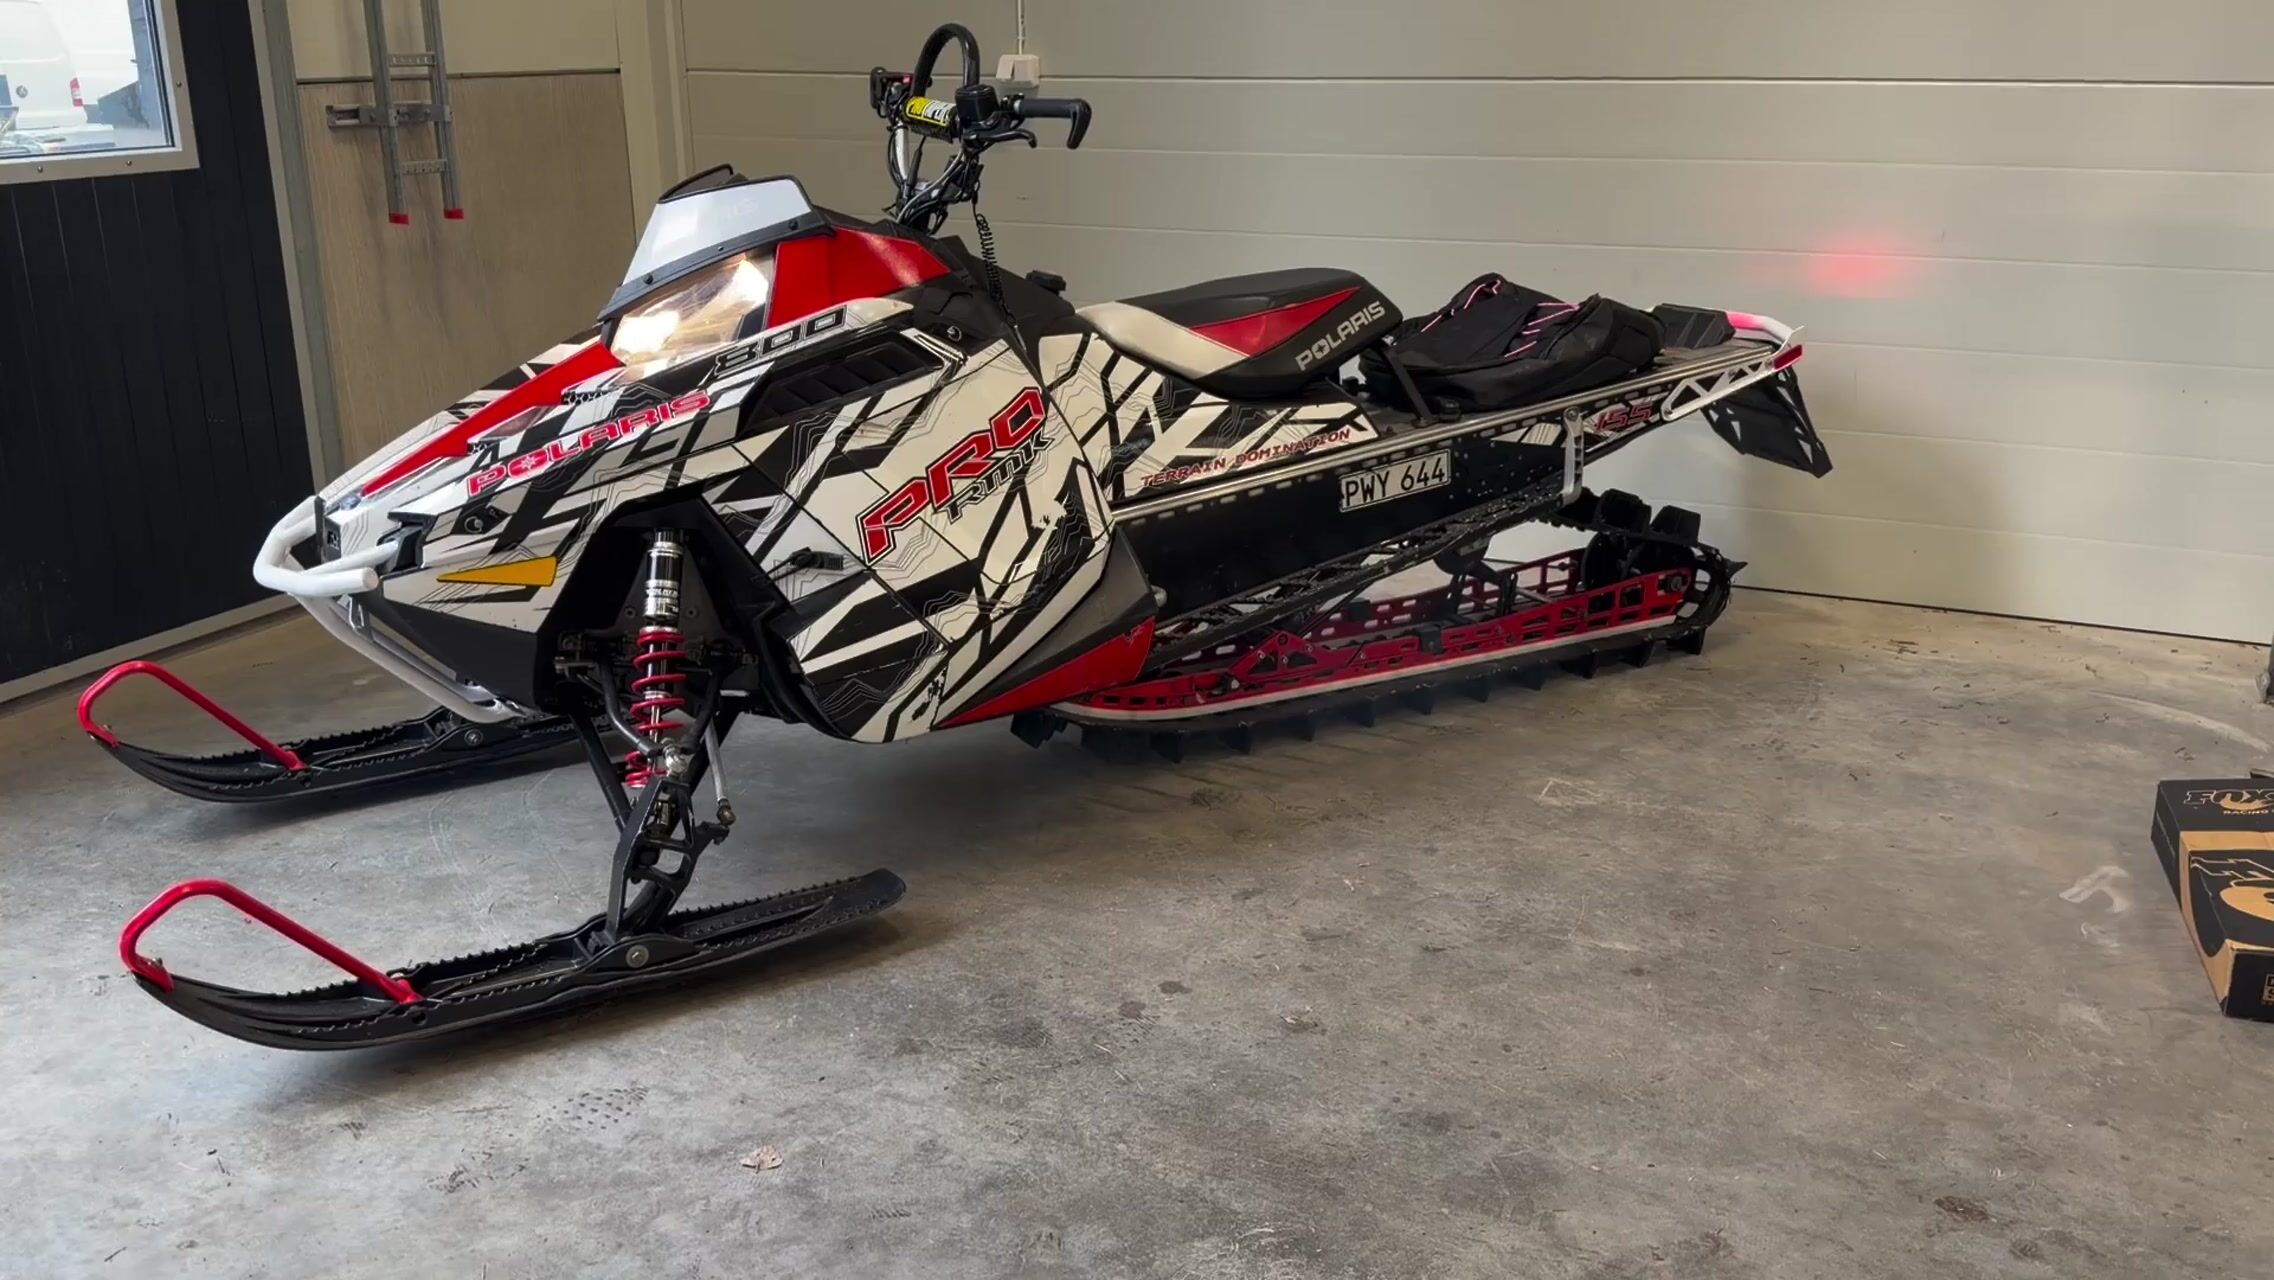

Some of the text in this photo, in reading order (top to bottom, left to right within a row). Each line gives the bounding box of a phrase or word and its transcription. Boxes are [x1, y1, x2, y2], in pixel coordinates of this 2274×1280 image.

[714, 306, 846, 377] 800
[1295, 301, 1386, 371] POLARIS
[466, 389, 711, 497] POLARIS
[857, 387, 1046, 565] PRO
[1141, 428, 1350, 487] TERRAIN DOMINATION
[1345, 457, 1445, 506] PWY 644
